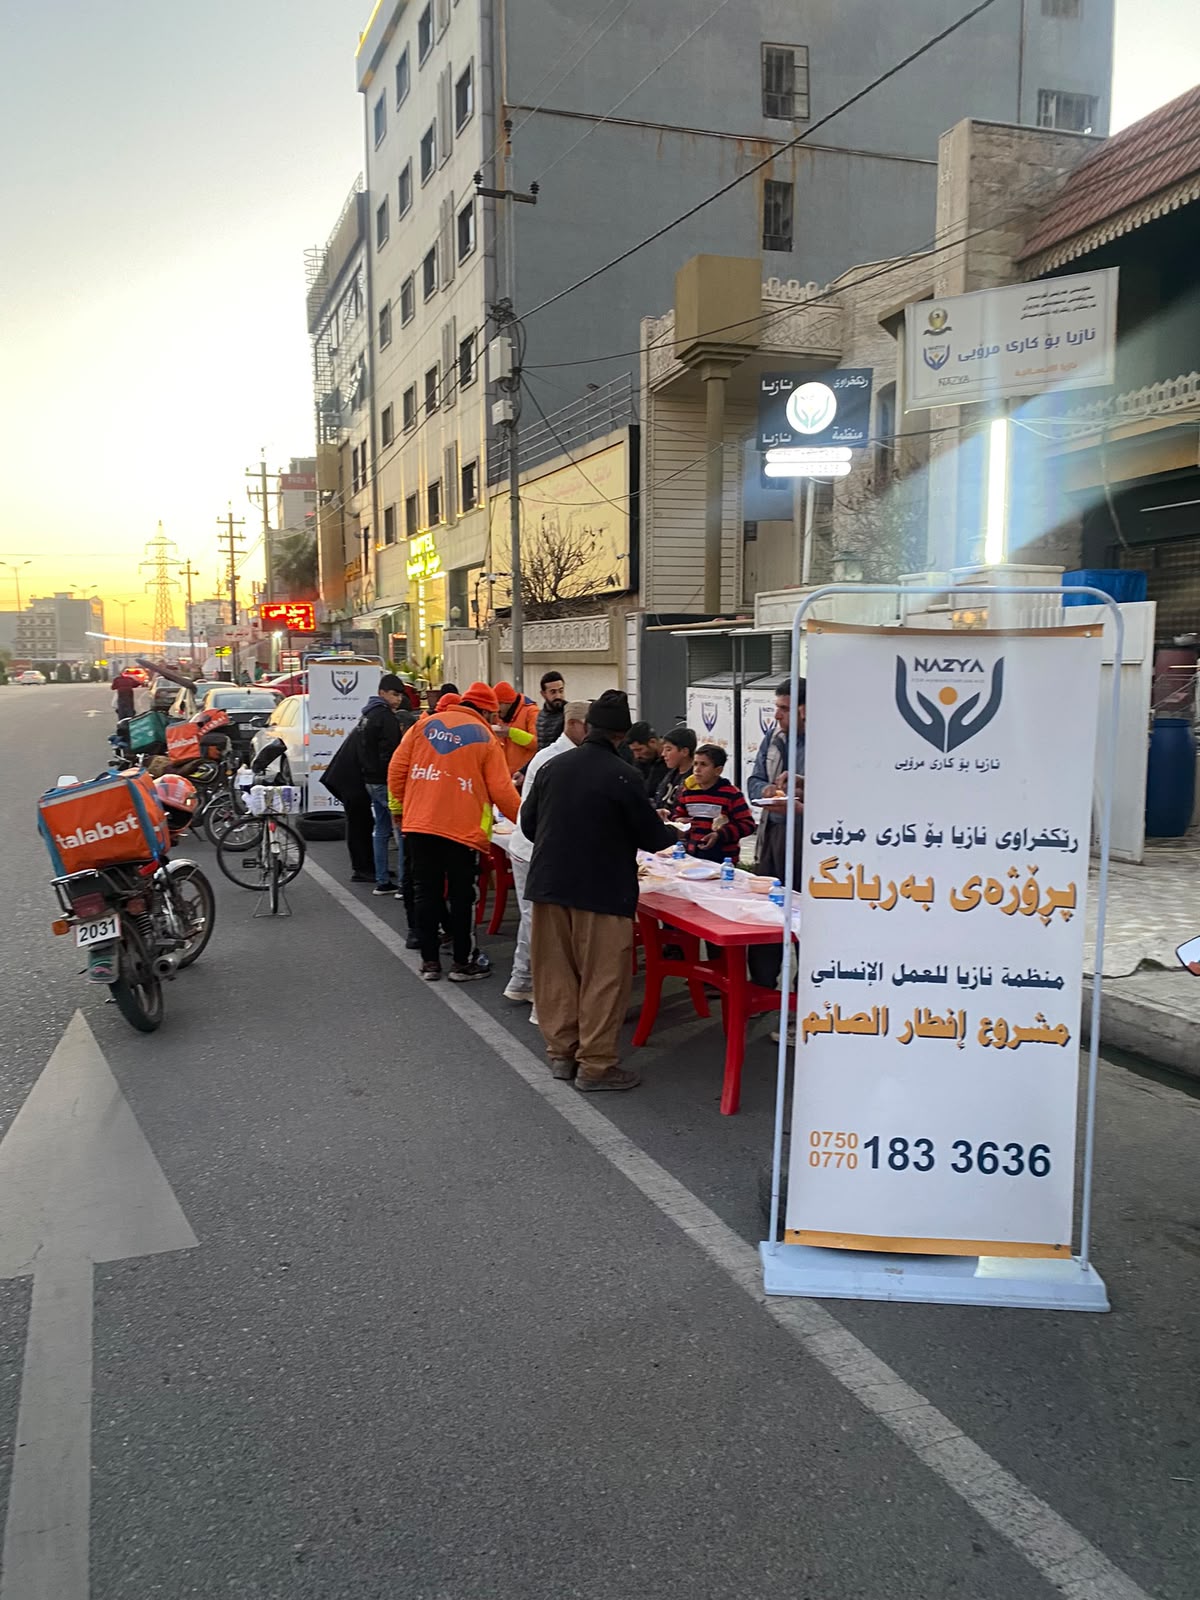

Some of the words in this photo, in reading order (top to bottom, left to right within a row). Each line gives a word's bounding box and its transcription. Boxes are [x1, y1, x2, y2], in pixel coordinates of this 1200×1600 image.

[914, 657, 985, 673] NAZYA
[975, 758, 1000, 772] نازیا
[56, 813, 140, 850] talabat
[876, 823, 917, 847] کاری
[923, 822, 943, 848] بۆ
[951, 825, 988, 849] نازیا
[808, 856, 934, 911] بەربانگ
[79, 919, 116, 942] 2031
[811, 960, 883, 988] الإنساني
[892, 963, 948, 986] للعمل
[1001, 967, 1064, 990] منظمة
[802, 1001, 889, 1045] الصائم
[896, 1008, 967, 1050] إفطار
[977, 1012, 1071, 1050] مشروع
[809, 1131, 859, 1149] 0750
[808, 1151, 859, 1170] 0770
[863, 1135, 935, 1172] 183
[950, 1140, 1051, 1178] 3636
